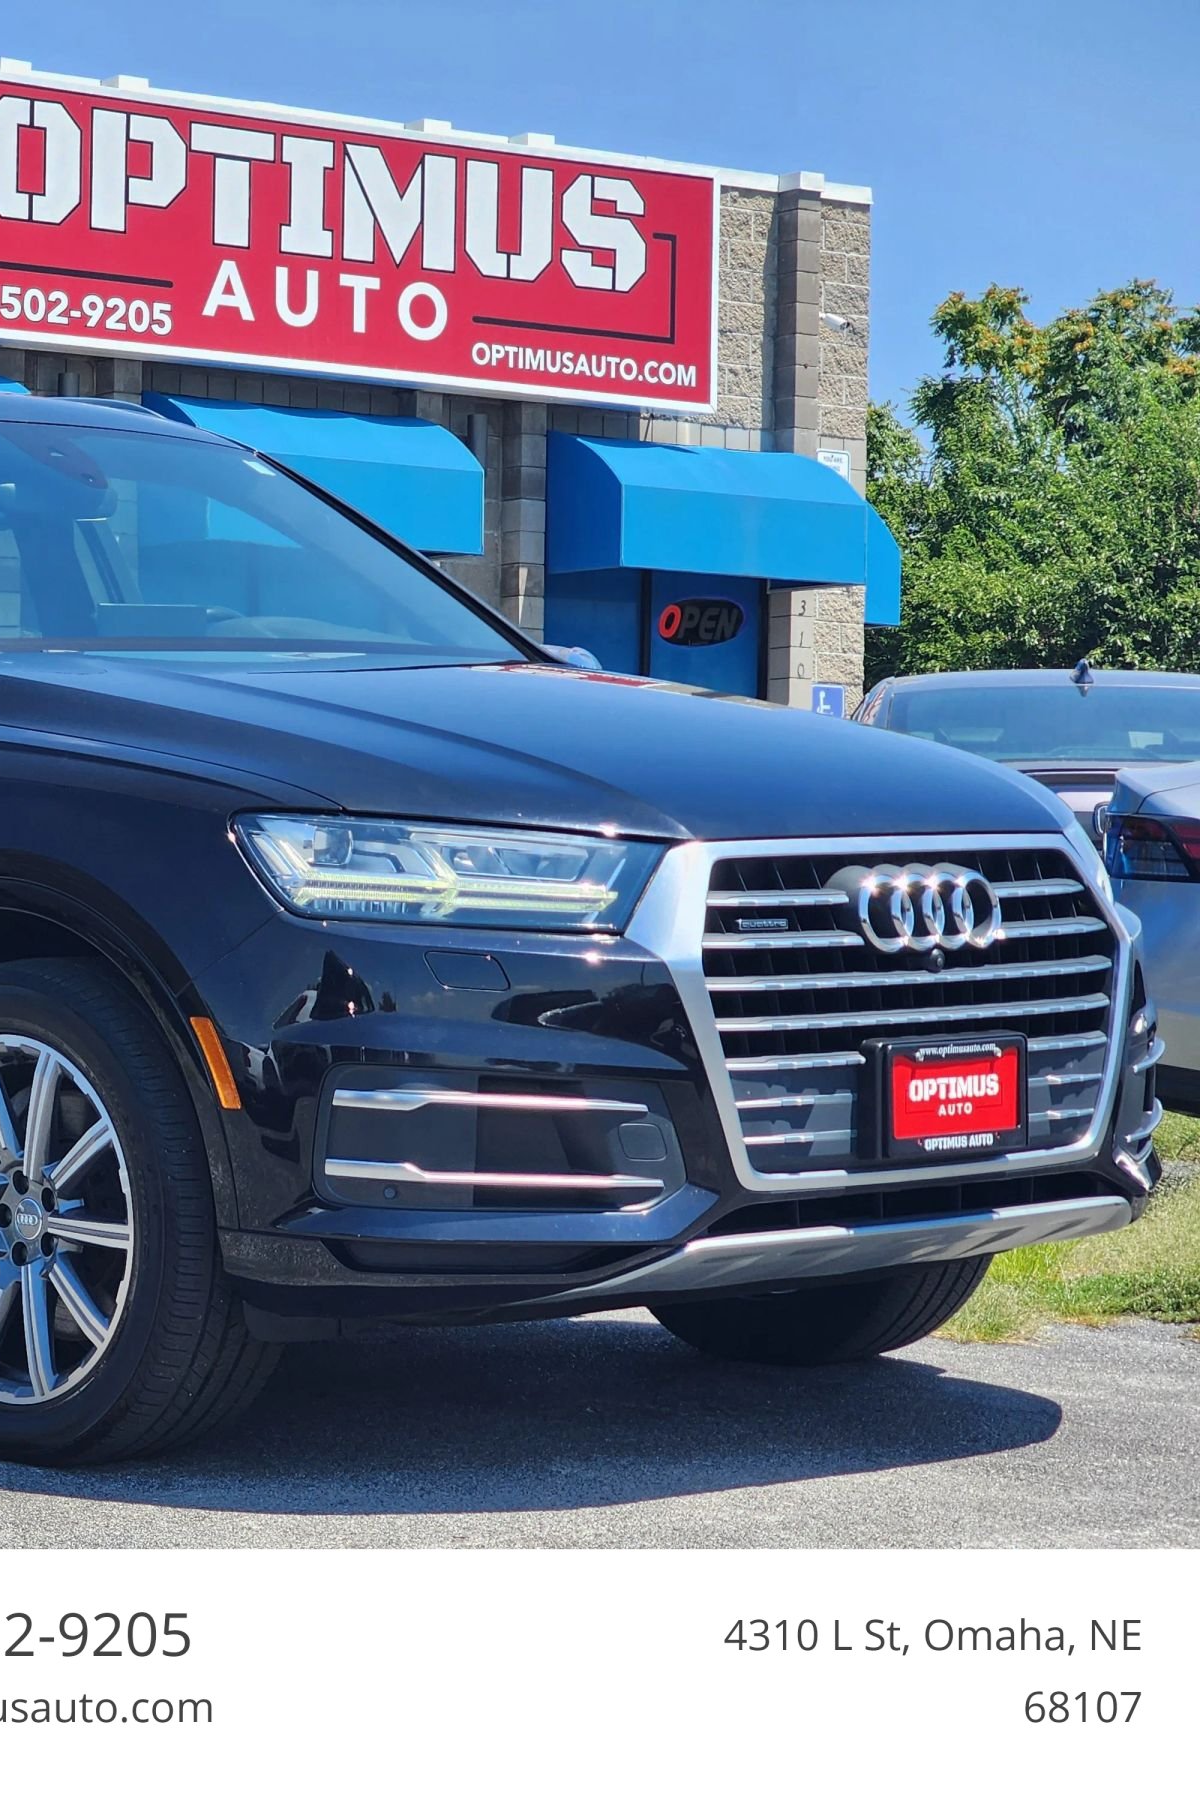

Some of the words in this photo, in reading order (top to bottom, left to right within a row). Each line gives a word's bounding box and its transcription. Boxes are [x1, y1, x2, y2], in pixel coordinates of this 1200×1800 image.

[202, 259, 448, 341] AUTO
[471, 342, 697, 388] OPTIMUSAUTO.COM
[658, 604, 740, 641] OPEN
[919, 1043, 996, 1059] www.optimusauto.com
[908, 1073, 1000, 1102] OPTIMUS
[938, 1102, 973, 1117] AUTO
[924, 1135, 968, 1151] OPTIMUS
[969, 1133, 994, 1148] AUTO
